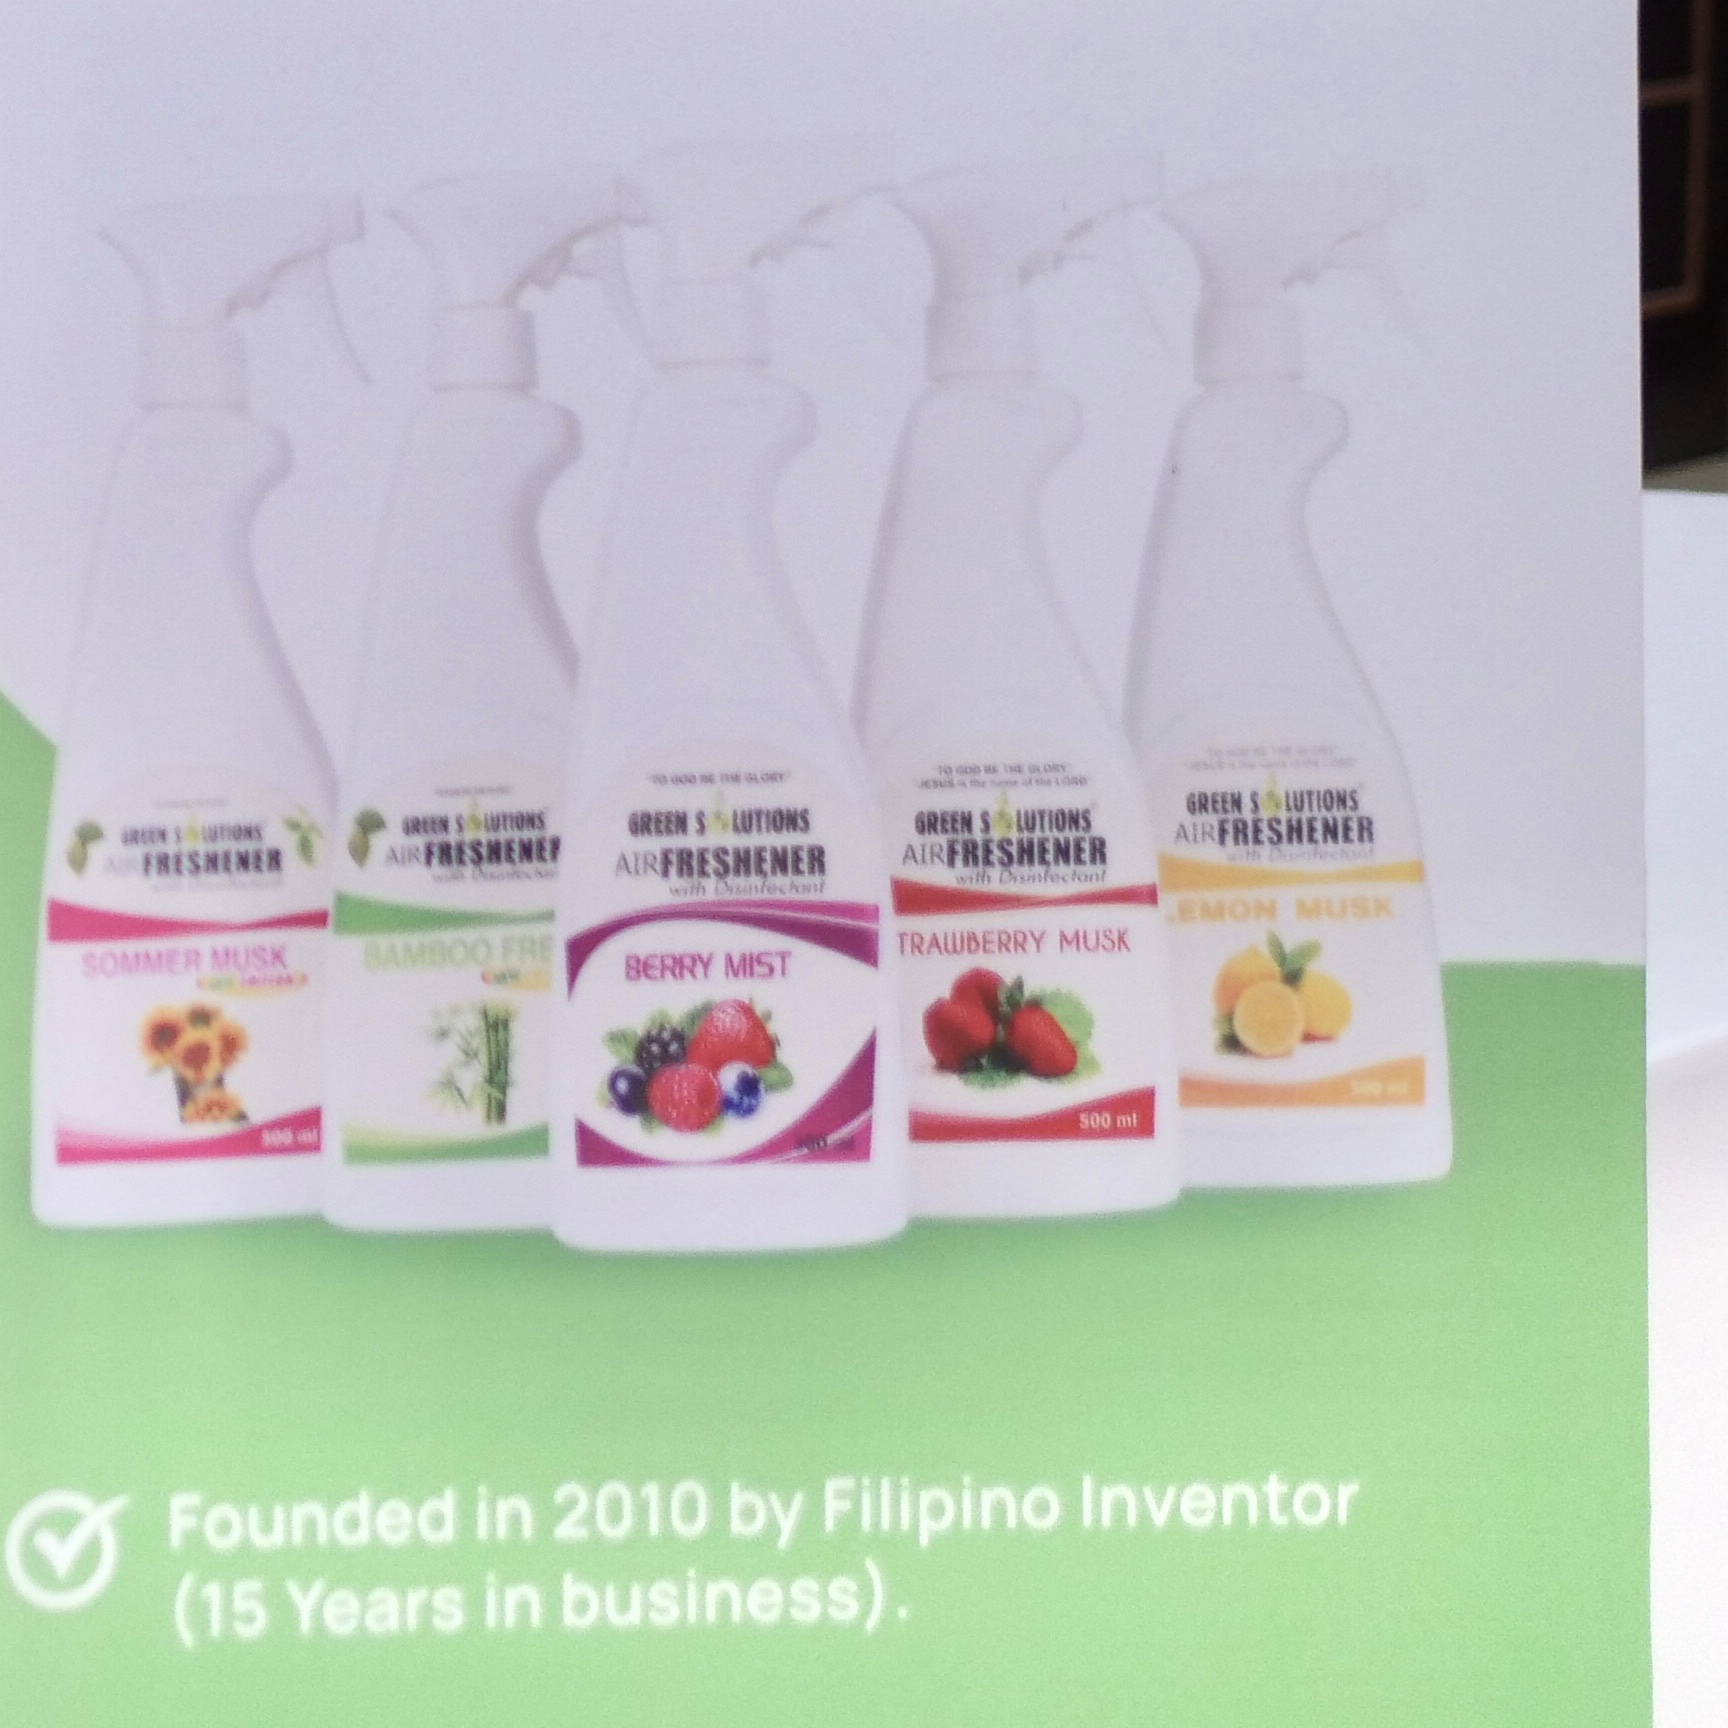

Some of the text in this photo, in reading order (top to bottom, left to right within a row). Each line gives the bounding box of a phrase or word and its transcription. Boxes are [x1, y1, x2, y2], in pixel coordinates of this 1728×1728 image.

[1185, 790, 1243, 816] GREEN
[121, 826, 168, 846] GREEN
[401, 814, 449, 837] GREEN
[628, 810, 688, 838] GREEN
[914, 810, 973, 836] GREEN
[955, 869, 992, 886] with
[1294, 895, 1394, 921] MUSK
[364, 934, 492, 974] BAMBOO
[896, 927, 1132, 957] TRAWBERRY MUSK
[209, 943, 289, 972] MUSK
[624, 950, 793, 982] BERRY MIST
[1079, 1110, 1139, 1130] 500 ml
[167, 1471, 1360, 1553] Founded in 2010 by Filipino Inventor
[173, 1556, 909, 1650] (15 Years in business).
